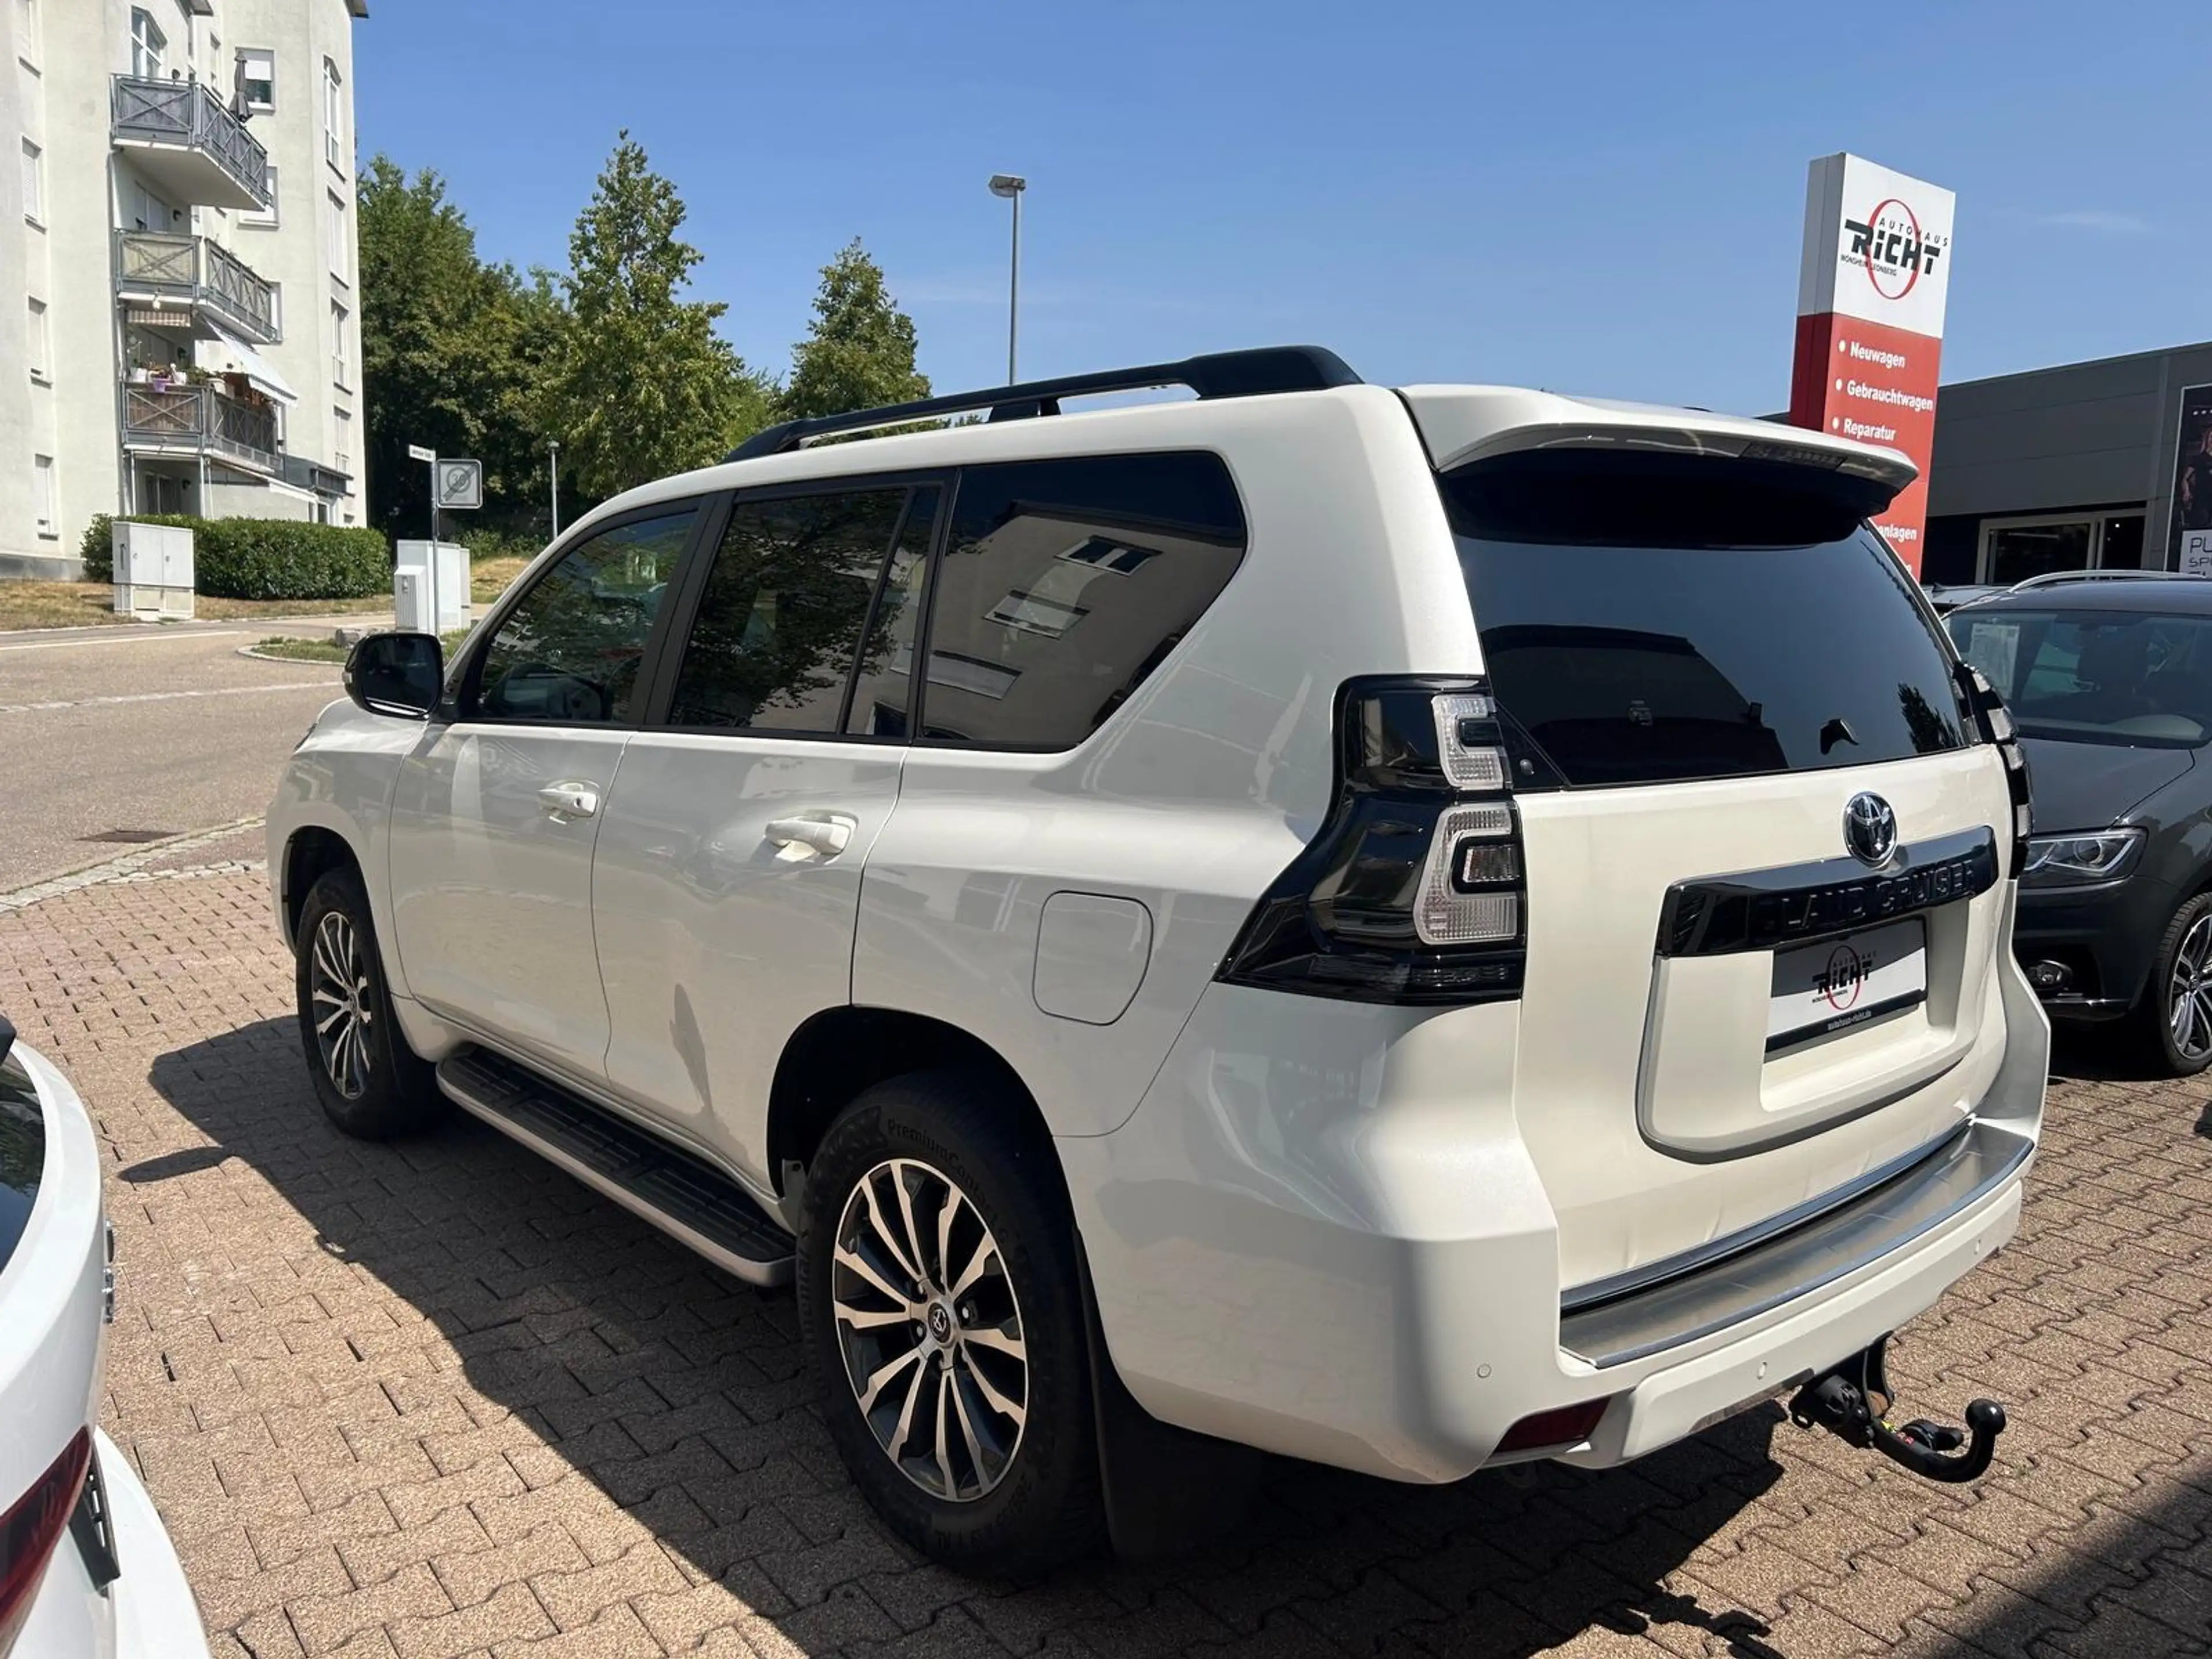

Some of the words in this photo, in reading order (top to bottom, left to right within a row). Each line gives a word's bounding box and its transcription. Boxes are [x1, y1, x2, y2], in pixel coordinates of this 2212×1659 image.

[1850, 341, 1906, 369] Neuwagen
[1847, 380, 1934, 412] Gebrauchtwagen
[1844, 418, 1896, 441] Reparatur
[2188, 556, 2212, 567] SP
[1782, 887, 1866, 930] LAND
[1876, 860, 1975, 912] CRUISER
